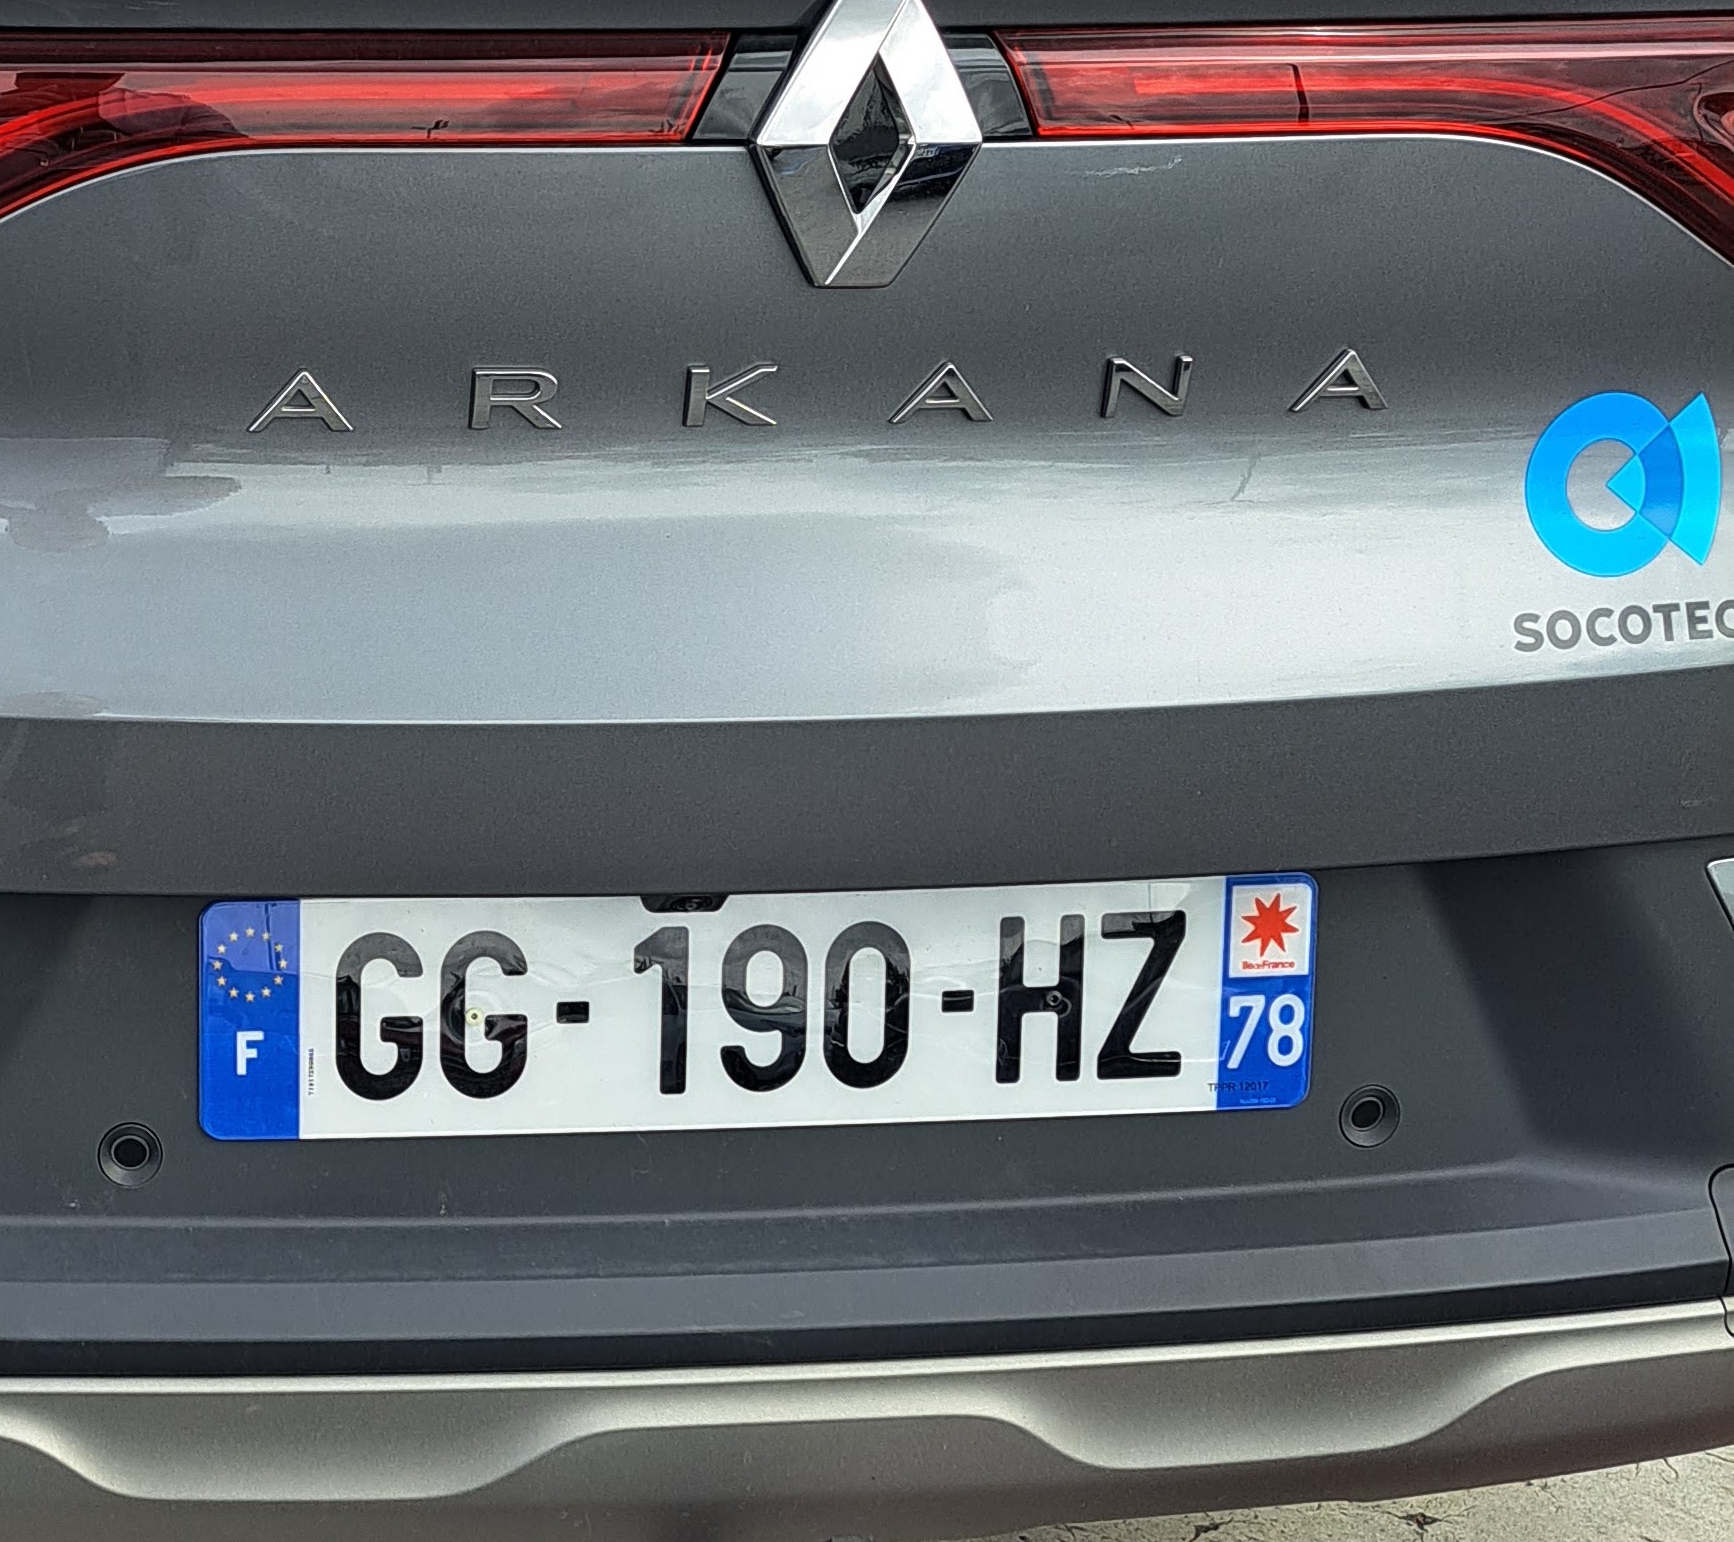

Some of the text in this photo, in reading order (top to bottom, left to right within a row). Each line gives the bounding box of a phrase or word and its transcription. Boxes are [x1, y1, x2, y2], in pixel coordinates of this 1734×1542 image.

[247, 346, 1388, 434] ARKANA
[1513, 600, 1734, 652] SOCOTEC
[335, 909, 1188, 1101] GG-190-HZ
[1227, 994, 1305, 1069] 78
[237, 1031, 264, 1075] F
